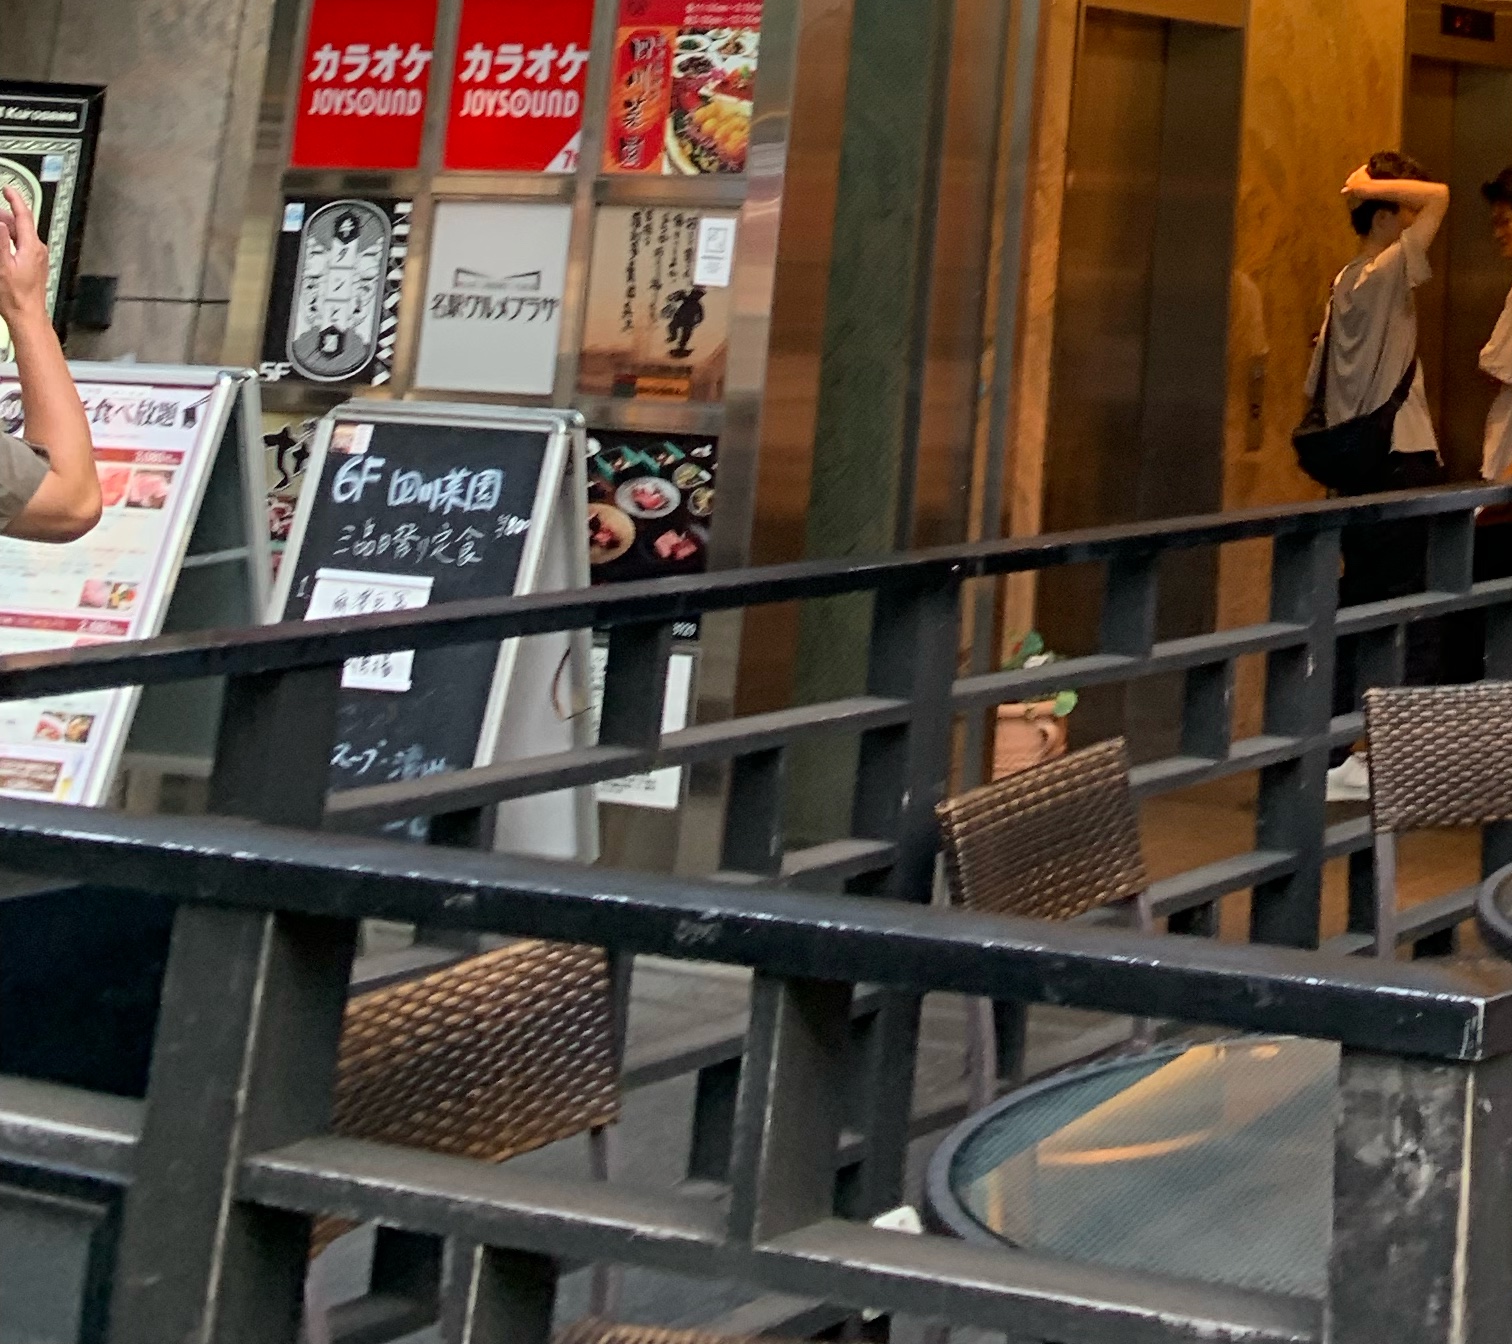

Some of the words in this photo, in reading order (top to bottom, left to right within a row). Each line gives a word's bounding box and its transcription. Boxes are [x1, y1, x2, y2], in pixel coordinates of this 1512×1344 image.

[307, 43, 434, 83] カラオケ
[459, 42, 590, 84] カラオケ
[307, 88, 423, 117] JOYSOUND
[459, 89, 580, 118] JOYSOUND
[332, 455, 386, 503] 6F
